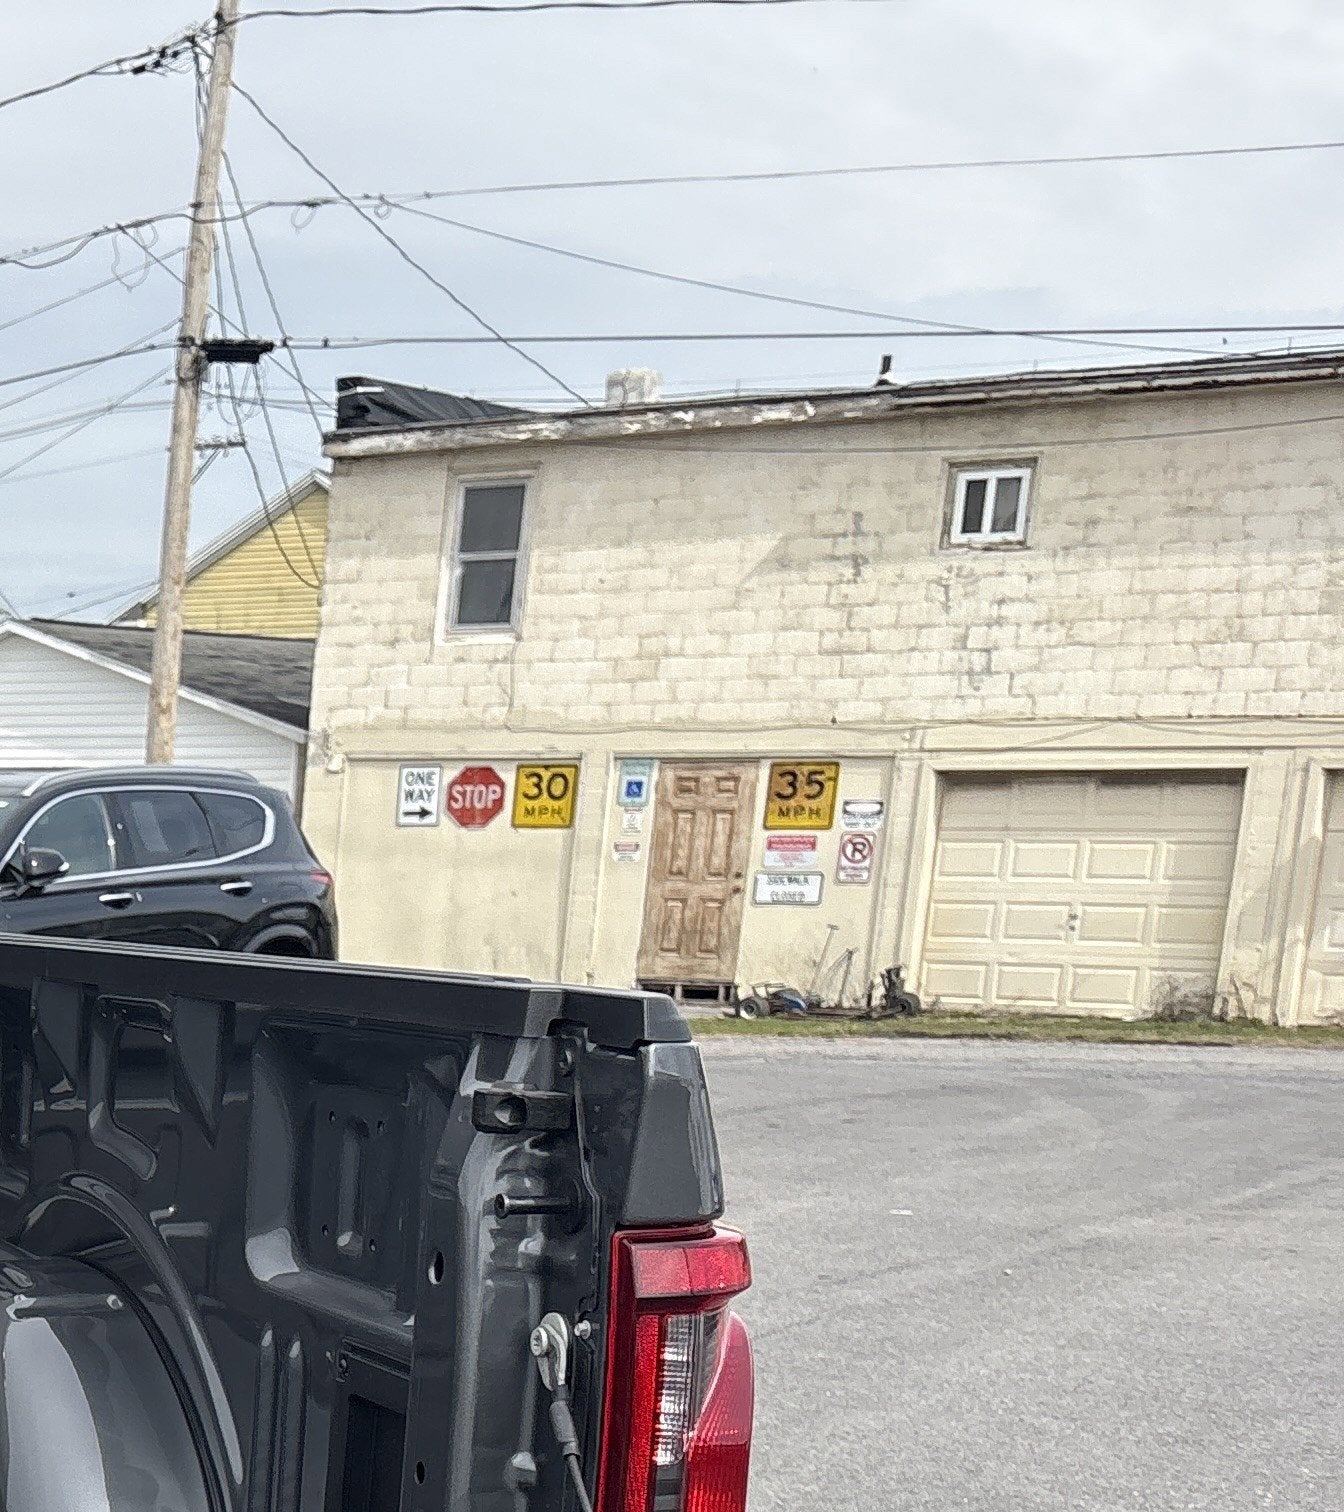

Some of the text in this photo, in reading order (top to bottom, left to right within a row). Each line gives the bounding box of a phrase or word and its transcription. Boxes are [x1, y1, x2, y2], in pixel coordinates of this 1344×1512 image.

[405, 771, 436, 787] ONE
[522, 771, 570, 801] 30
[775, 770, 826, 800] 35
[404, 788, 435, 803] WAY
[450, 784, 502, 810] STOP
[524, 805, 562, 819] MPH
[777, 805, 822, 818] MPH
